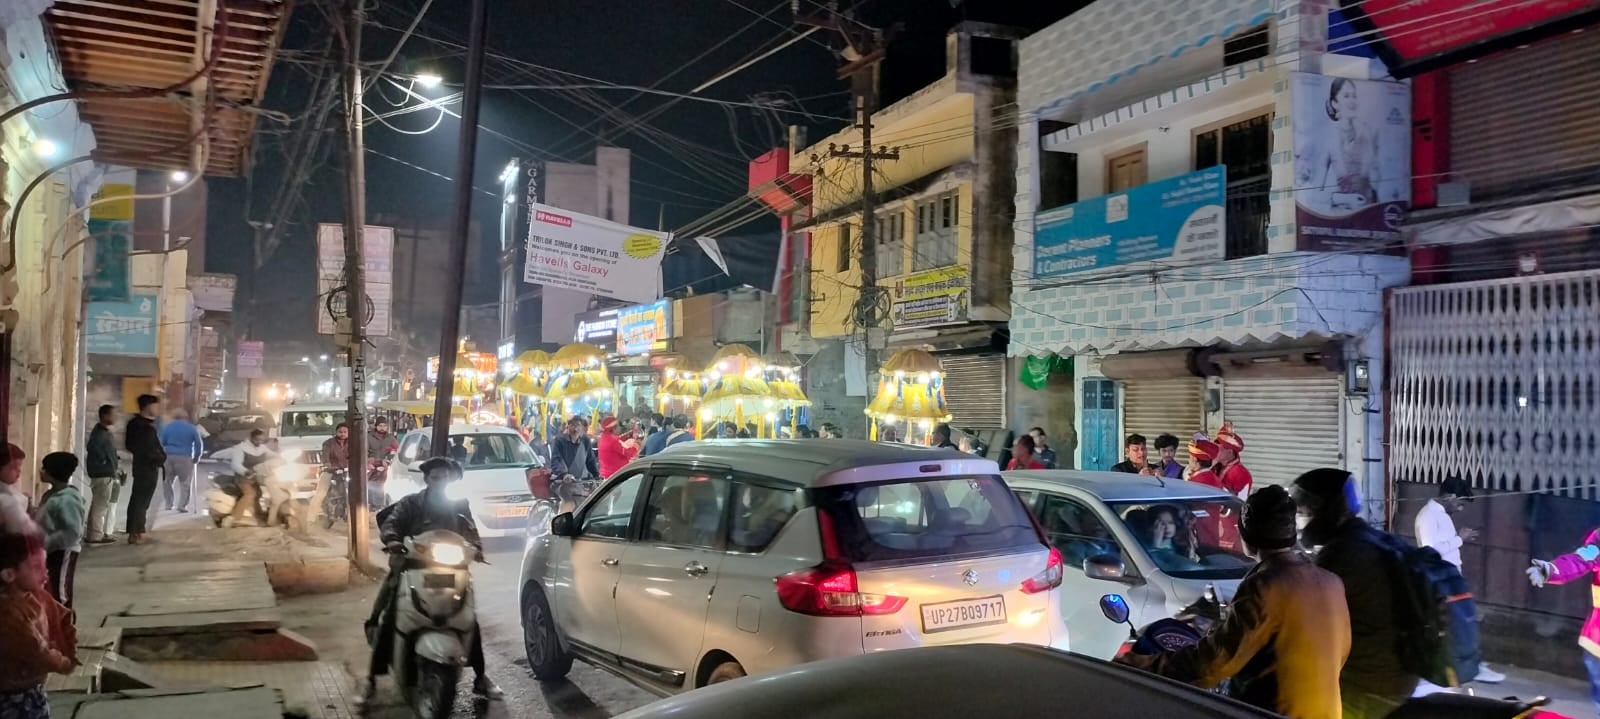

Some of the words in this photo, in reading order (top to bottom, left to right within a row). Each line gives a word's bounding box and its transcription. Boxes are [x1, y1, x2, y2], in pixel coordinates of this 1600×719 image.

[533, 235, 553, 245] TRILOK
[554, 239, 573, 249] SINGH
[574, 243, 578, 251] &
[580, 245, 596, 254] SONS
[530, 252, 569, 269] Havells
[573, 260, 609, 278] Galaxy
[589, 255, 611, 265] opening
[1044, 255, 1096, 273] Contractors
